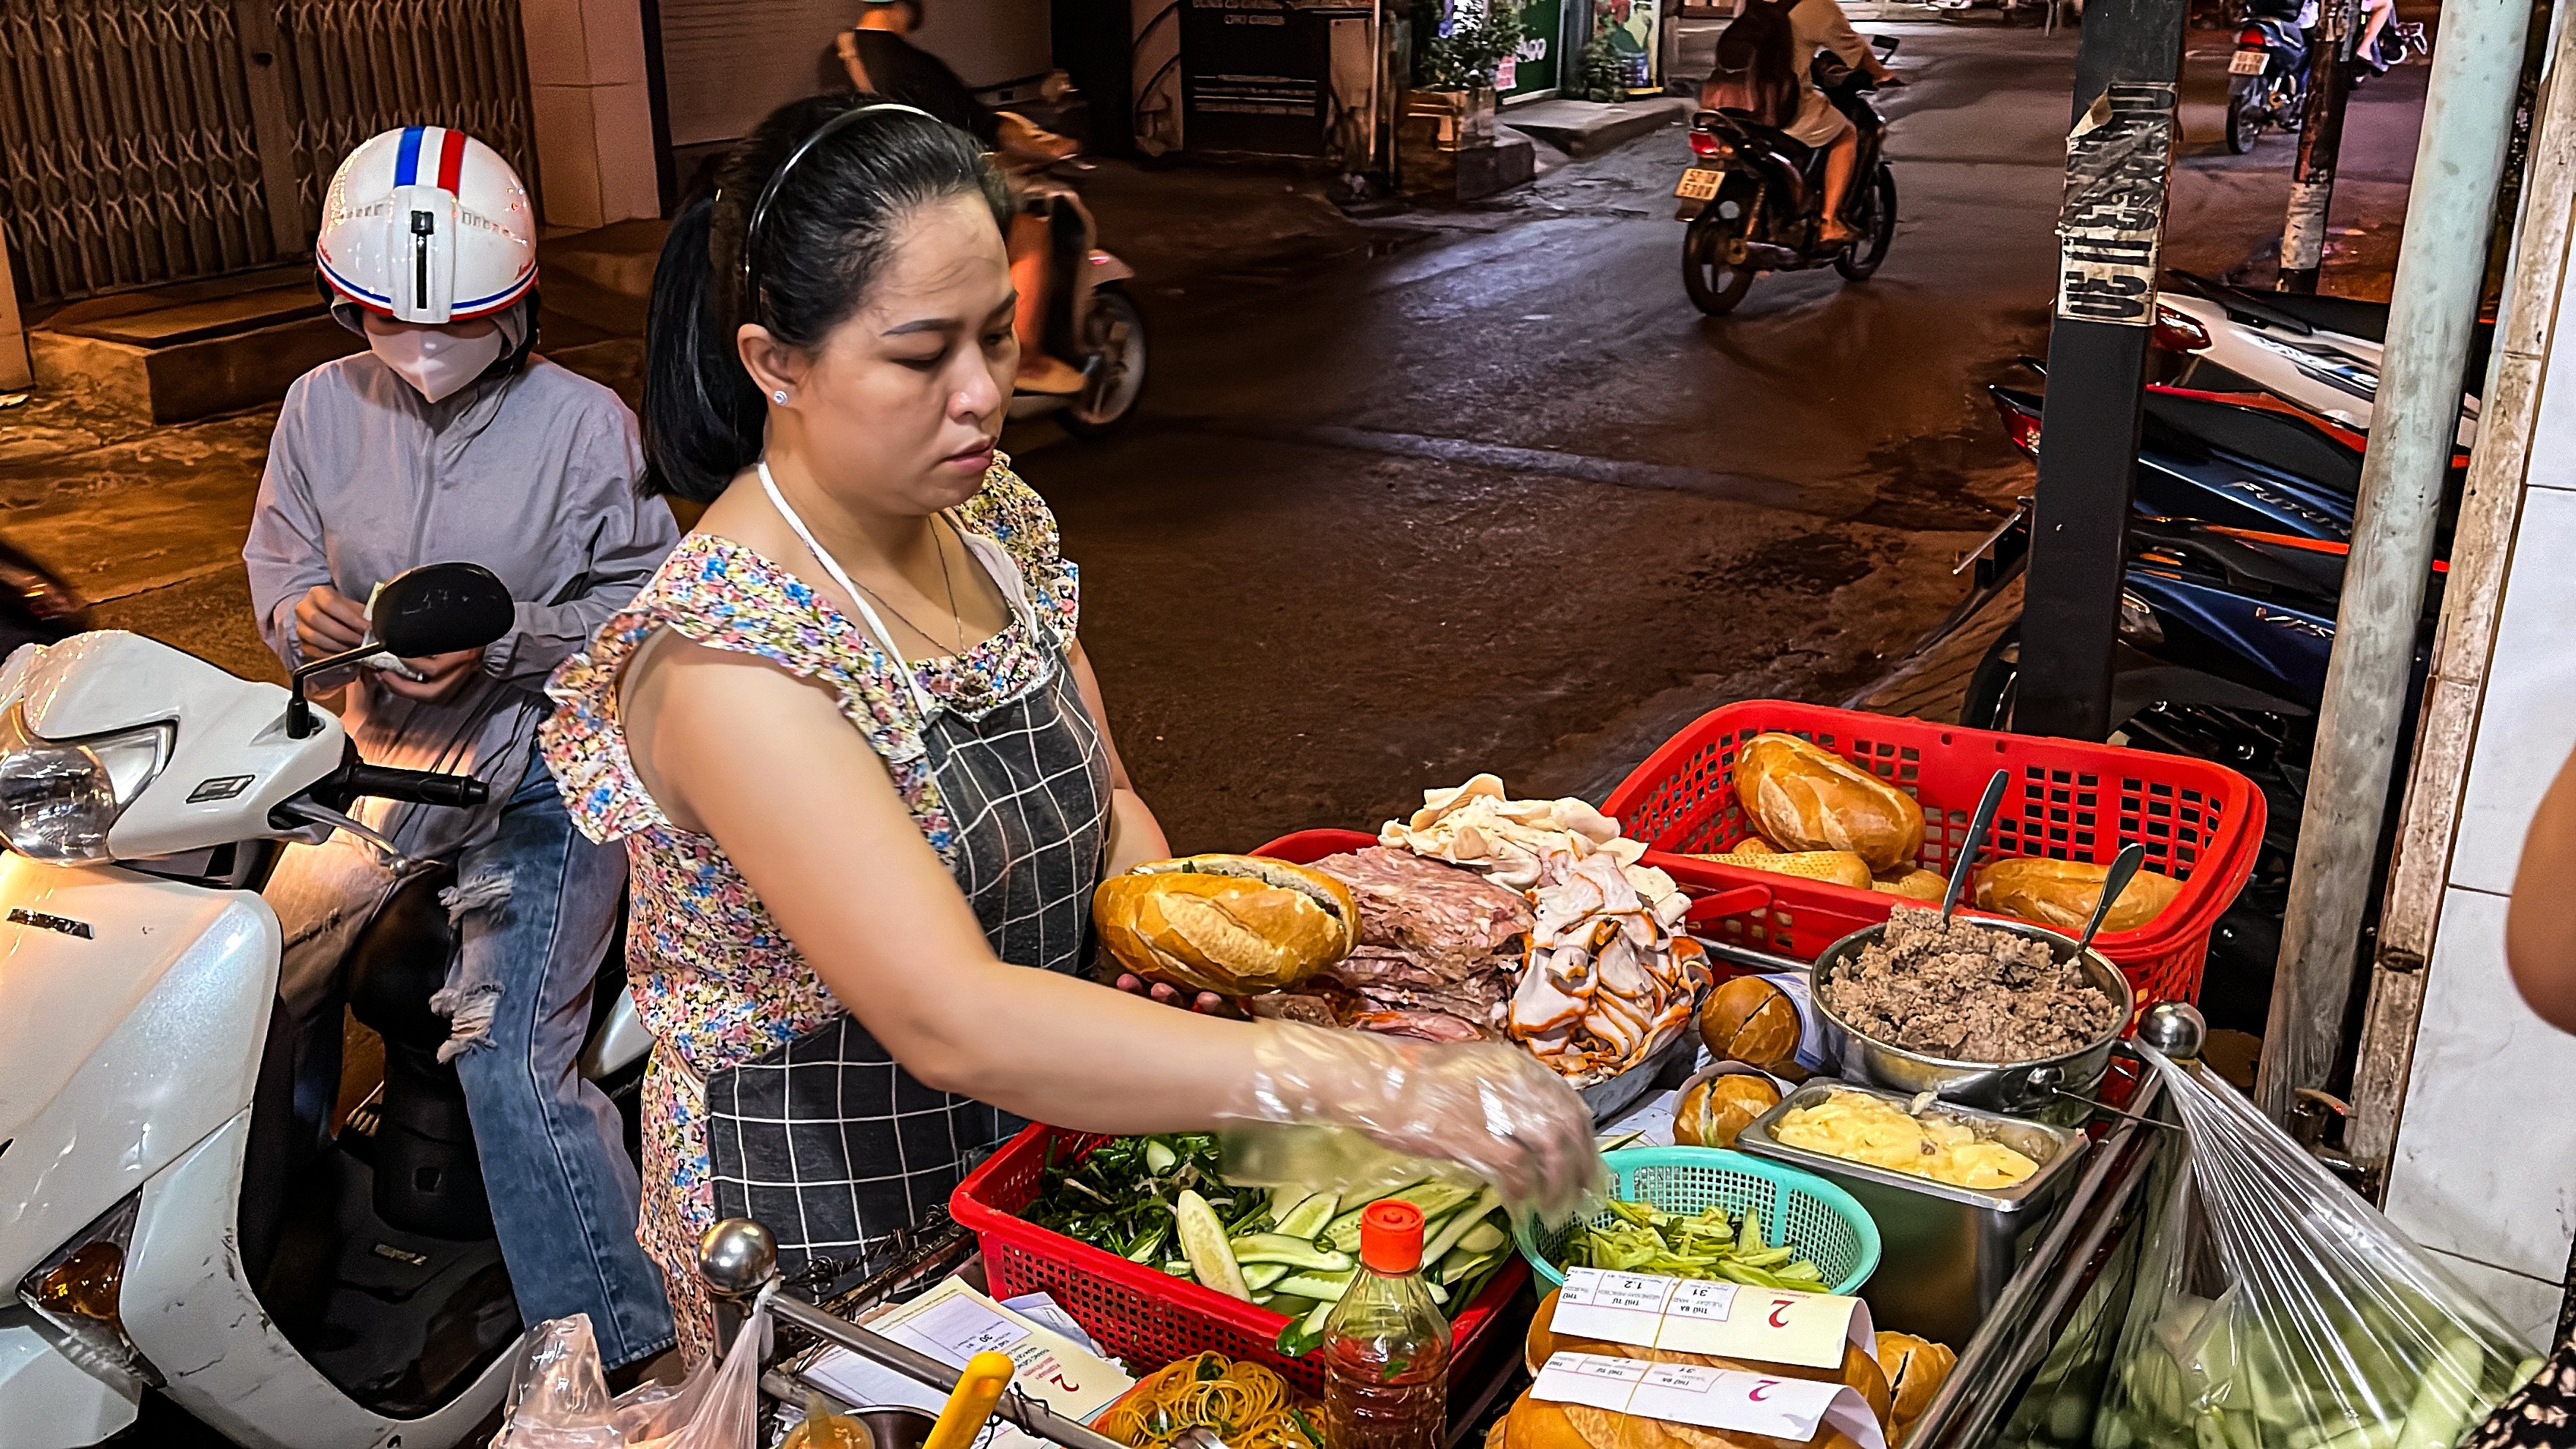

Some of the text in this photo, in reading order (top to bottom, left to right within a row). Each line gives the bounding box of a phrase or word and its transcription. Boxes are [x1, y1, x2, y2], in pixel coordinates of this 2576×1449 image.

[193, 777, 247, 795] FI
[1769, 1300, 1795, 1328] 2
[979, 1334, 992, 1343] 30
[1049, 1374, 1079, 1392] 2
[1749, 1379, 1782, 1401] 2
